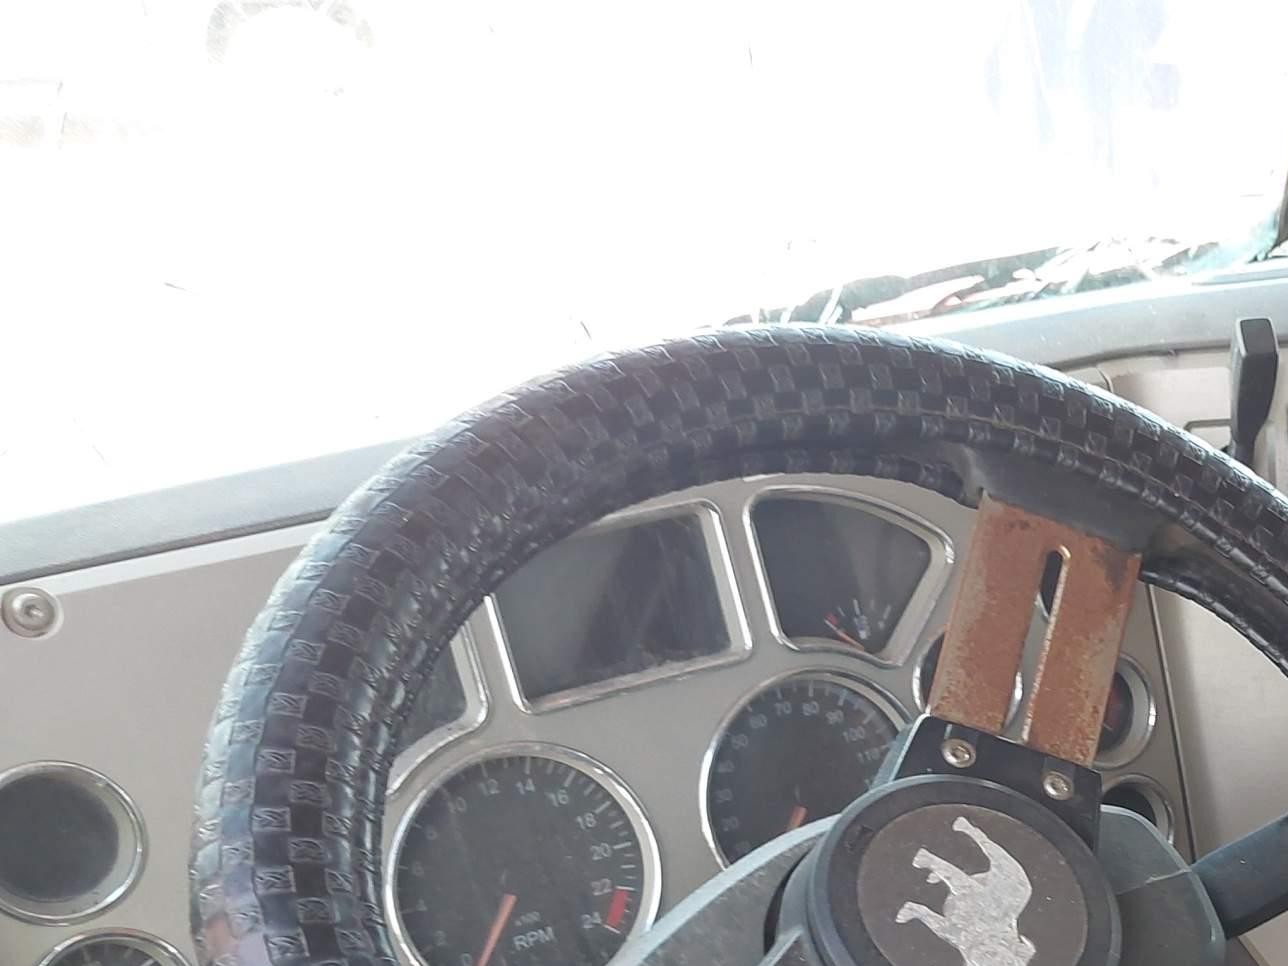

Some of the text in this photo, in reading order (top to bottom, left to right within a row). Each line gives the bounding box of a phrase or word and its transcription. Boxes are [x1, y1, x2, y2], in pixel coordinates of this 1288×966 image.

[480, 779, 500, 797] 12
[516, 778, 536, 796] 14
[549, 788, 570, 807] 16
[576, 812, 597, 831] 18
[590, 843, 612, 861] 20
[581, 912, 601, 929] 24
[513, 926, 557, 950] RPM
